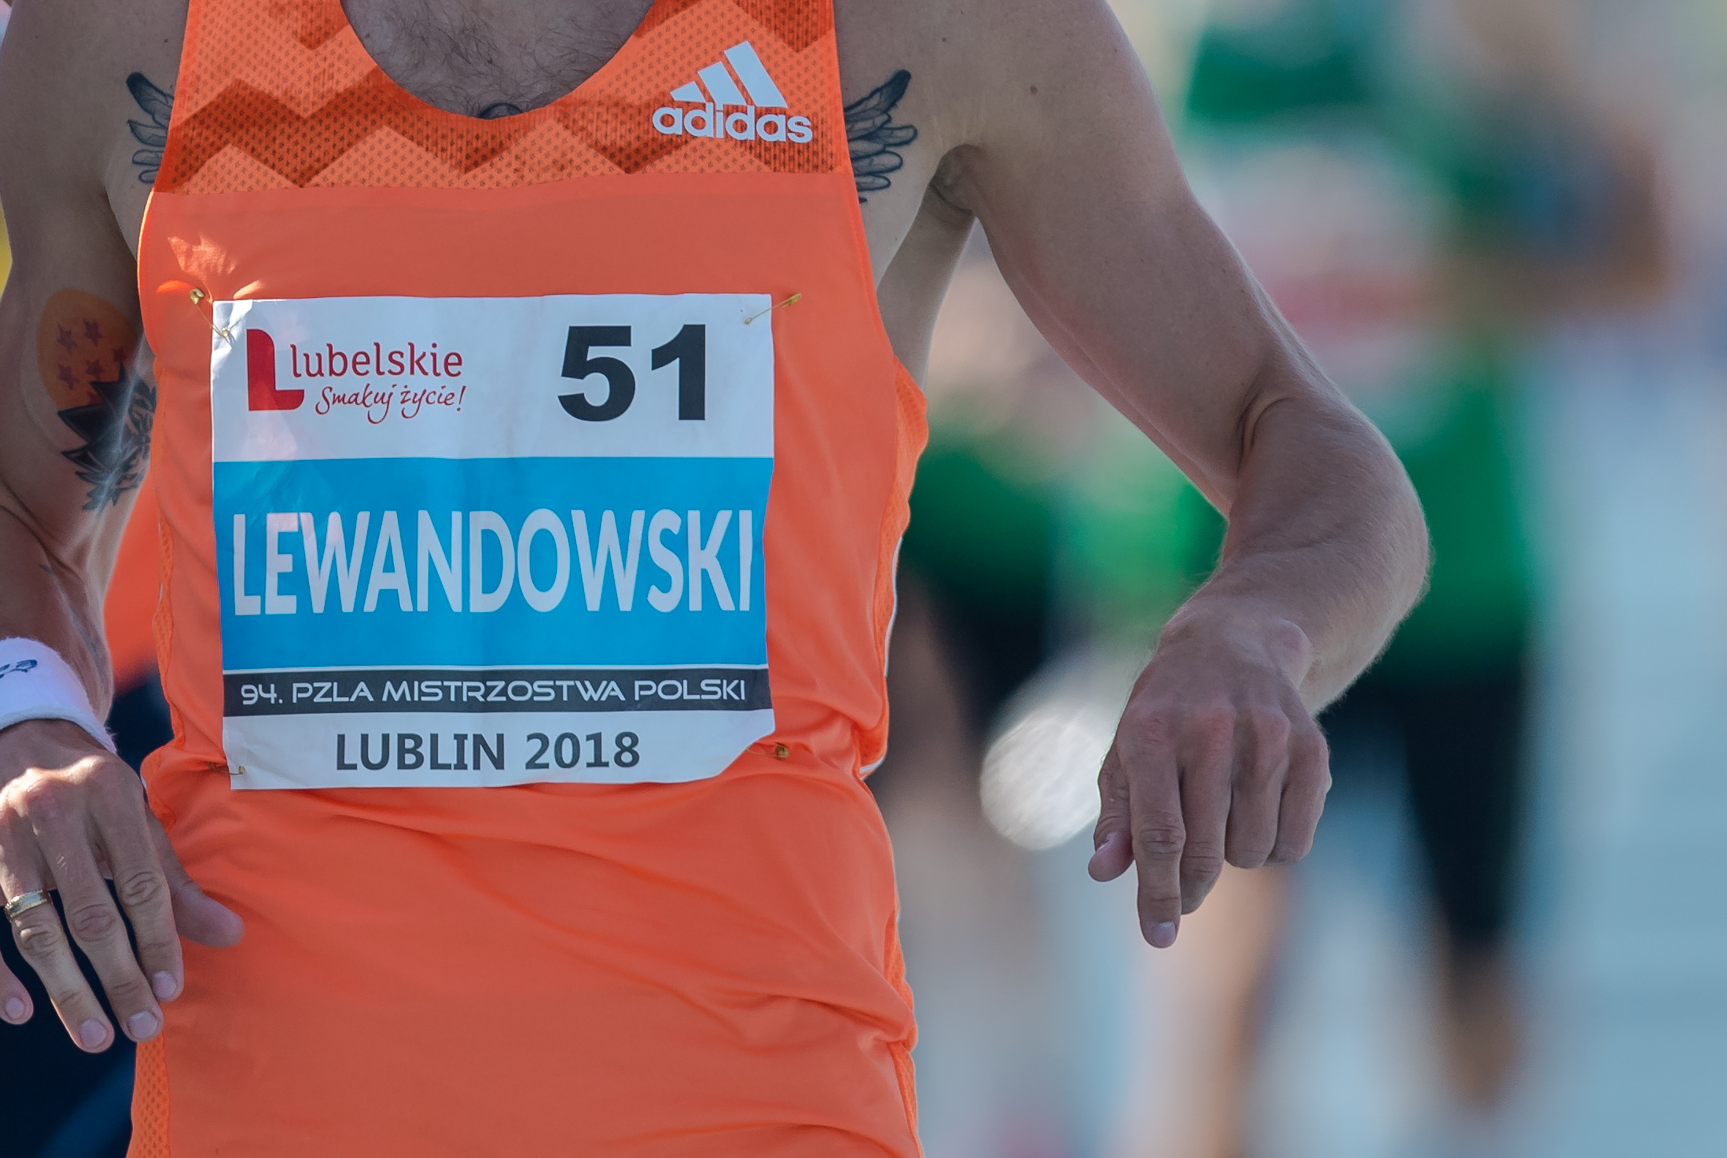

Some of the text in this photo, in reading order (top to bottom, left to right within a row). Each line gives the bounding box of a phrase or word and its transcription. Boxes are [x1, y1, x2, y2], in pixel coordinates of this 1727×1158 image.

[652, 102, 813, 143] adidas
[557, 323, 706, 422] 51
[315, 383, 467, 424] Smakuj życie!
[233, 508, 753, 616] LEWANDOWSKI
[240, 679, 746, 705] 94. PZLA MISTRZOSTWA POLSKI
[335, 731, 640, 772] LUBLIN 2018
